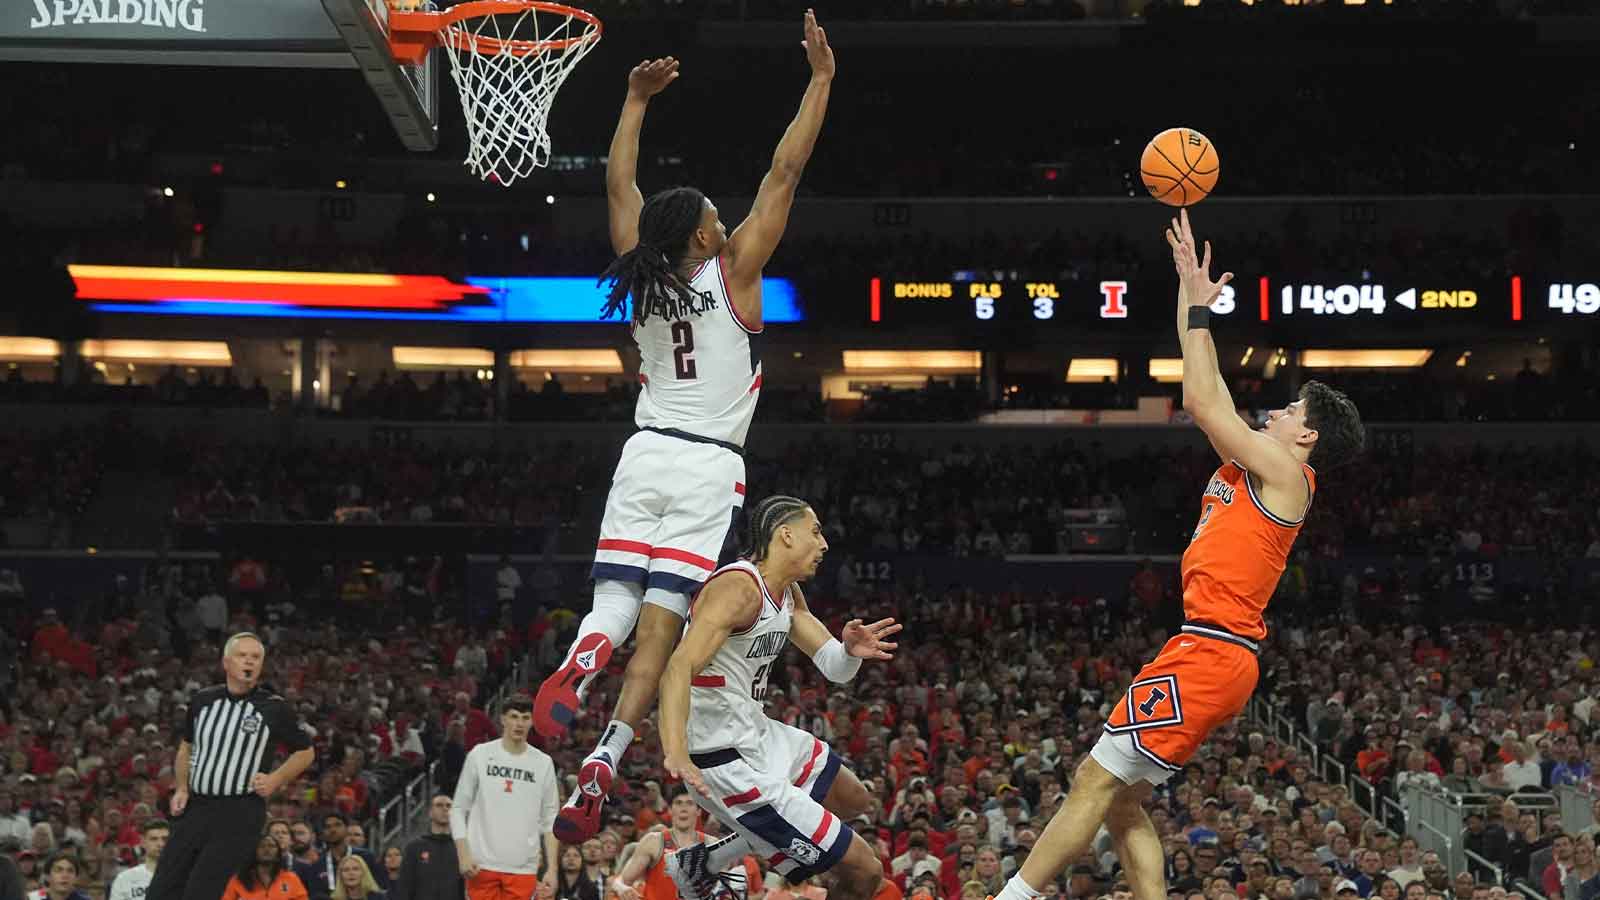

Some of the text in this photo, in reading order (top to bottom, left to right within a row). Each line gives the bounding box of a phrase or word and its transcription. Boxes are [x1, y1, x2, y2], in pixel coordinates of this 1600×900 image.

[30, 0, 206, 32] SPALDING
[894, 284, 1059, 298] BONUS FLS TOL
[1281, 285, 1477, 314] 14:04 2ND
[1548, 283, 1600, 314] 49
[975, 298, 1054, 319] 5 3
[671, 321, 697, 380] 2
[855, 561, 891, 579] 112
[1455, 563, 1494, 580] 113
[1138, 686, 1168, 719] I
[486, 764, 513, 778] LOCK
[513, 767, 523, 780] IT
